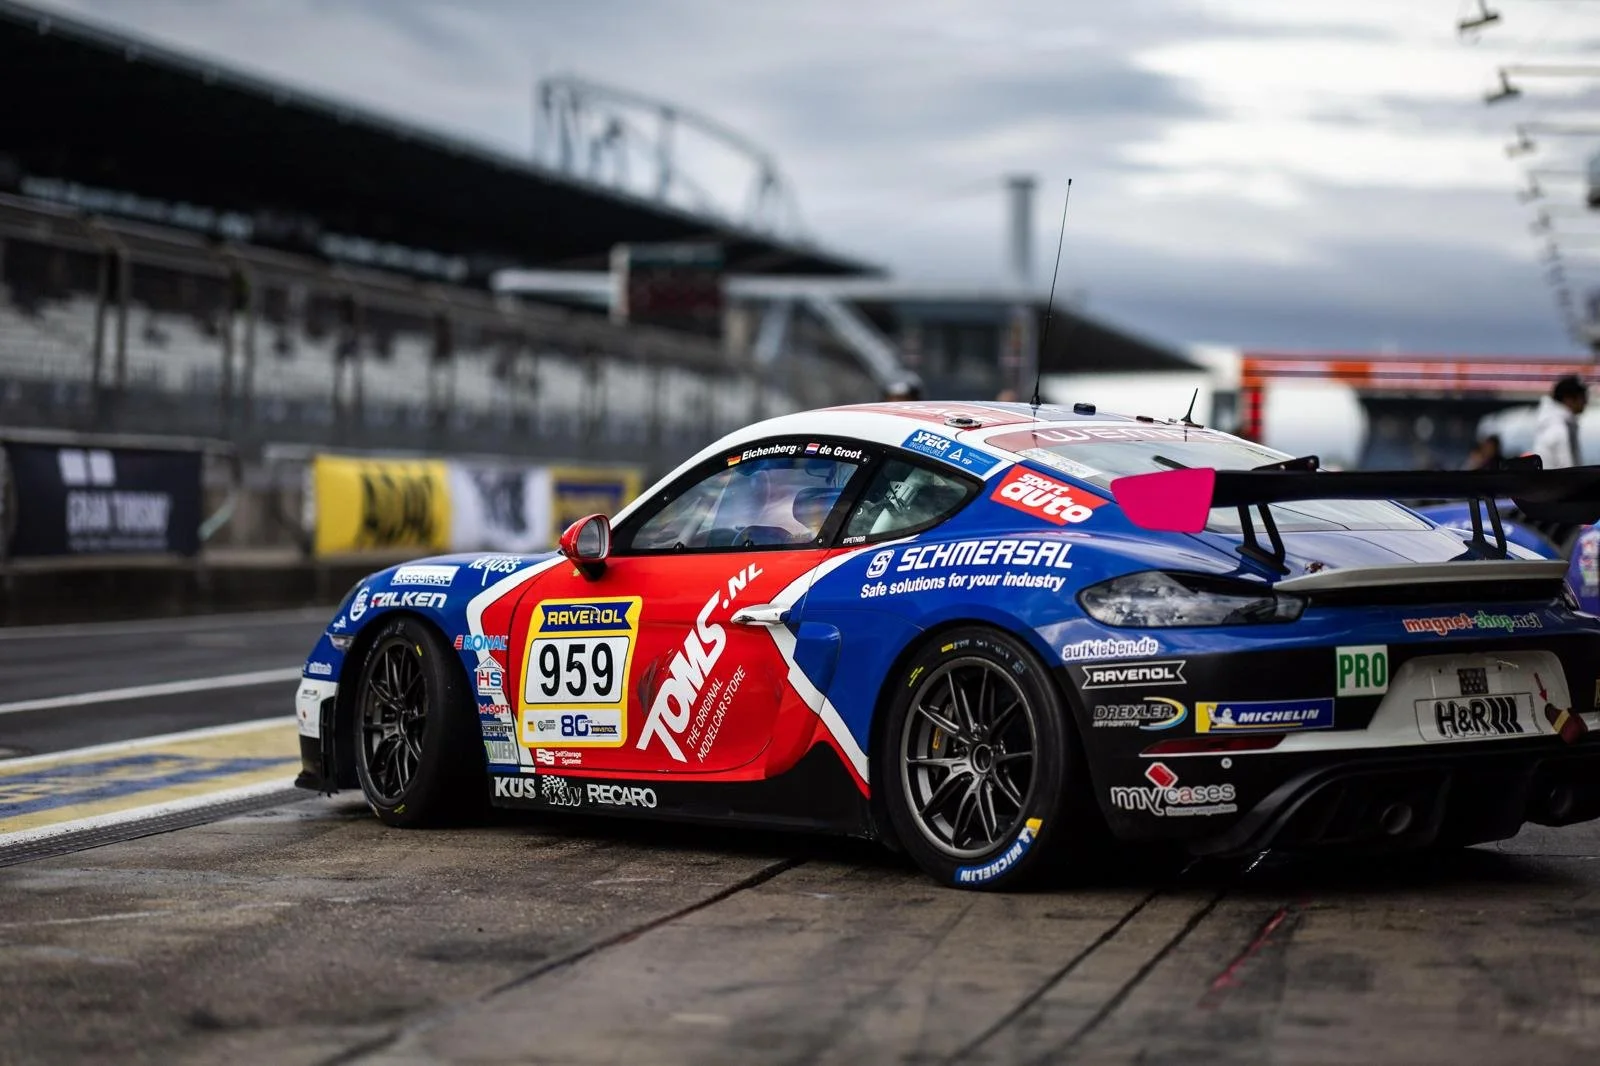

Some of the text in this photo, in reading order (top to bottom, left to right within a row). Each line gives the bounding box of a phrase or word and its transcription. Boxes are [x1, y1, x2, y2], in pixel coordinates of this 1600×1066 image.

[742, 445, 797, 460] Eichenberg
[819, 445, 862, 459] de Groot
[1018, 473, 1071, 497] sport
[1001, 483, 1093, 524] auto
[897, 540, 1073, 572] SCHMERSAL
[860, 572, 1065, 598] Safe solutions for your industry
[370, 592, 447, 608] FALKEN
[547, 608, 622, 625] RAVENOL
[463, 634, 508, 651] RONAL
[1062, 637, 1158, 660] aufkleben.de
[539, 642, 614, 697] 959
[1092, 667, 1175, 682] RAVENOL
[1339, 652, 1387, 688] PRO
[723, 665, 746, 704] STORE
[686, 677, 724, 749] THE ORIGINAL
[1093, 705, 1173, 720] DREXLER
[1238, 709, 1320, 723] MICHELIN
[561, 714, 589, 736] 80
[494, 776, 536, 798] KÜS
[587, 784, 657, 808] RECARO
[960, 842, 1023, 882] MICHELIN
